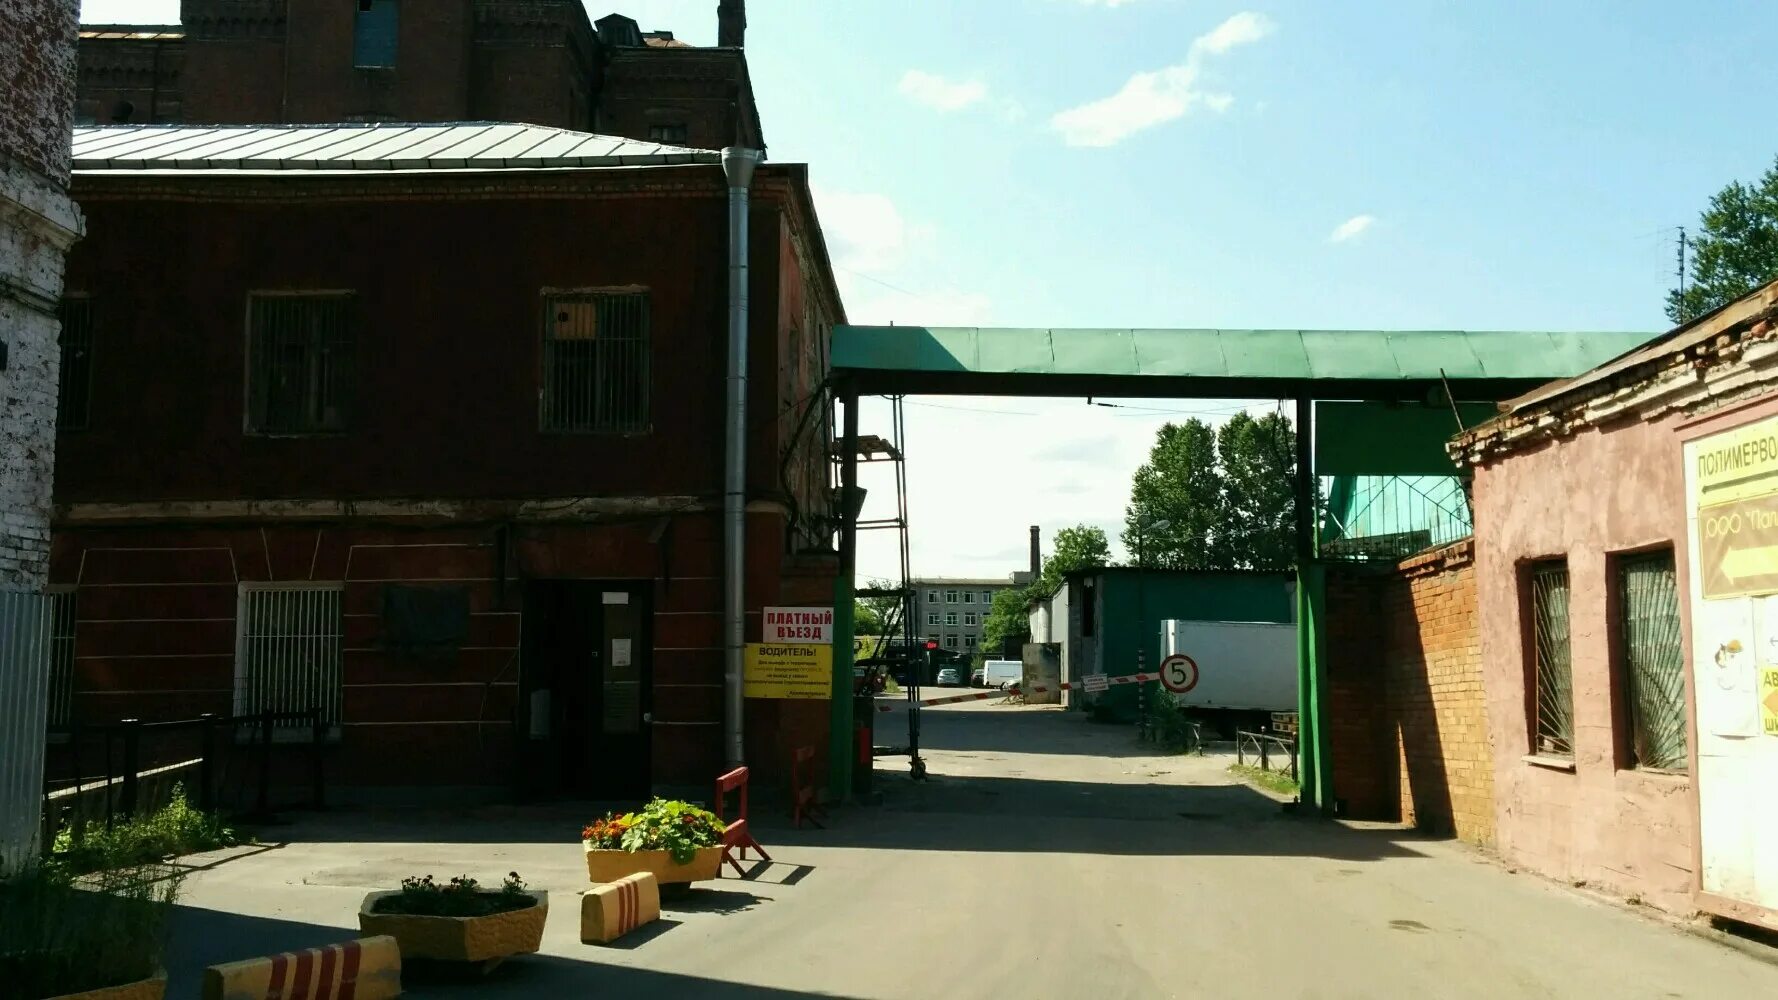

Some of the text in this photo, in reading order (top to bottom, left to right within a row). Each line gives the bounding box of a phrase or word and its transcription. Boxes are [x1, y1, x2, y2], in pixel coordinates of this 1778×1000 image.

[1698, 435, 1778, 478] ПОЛИМЕРВО
[1706, 513, 1741, 538] ООО
[767, 610, 832, 624] ПЛАТНЫЙ
[777, 627, 822, 640] ВЪЕЗД
[759, 647, 817, 657] ВОДИТЕЛЬ!
[1171, 661, 1187, 685] 5
